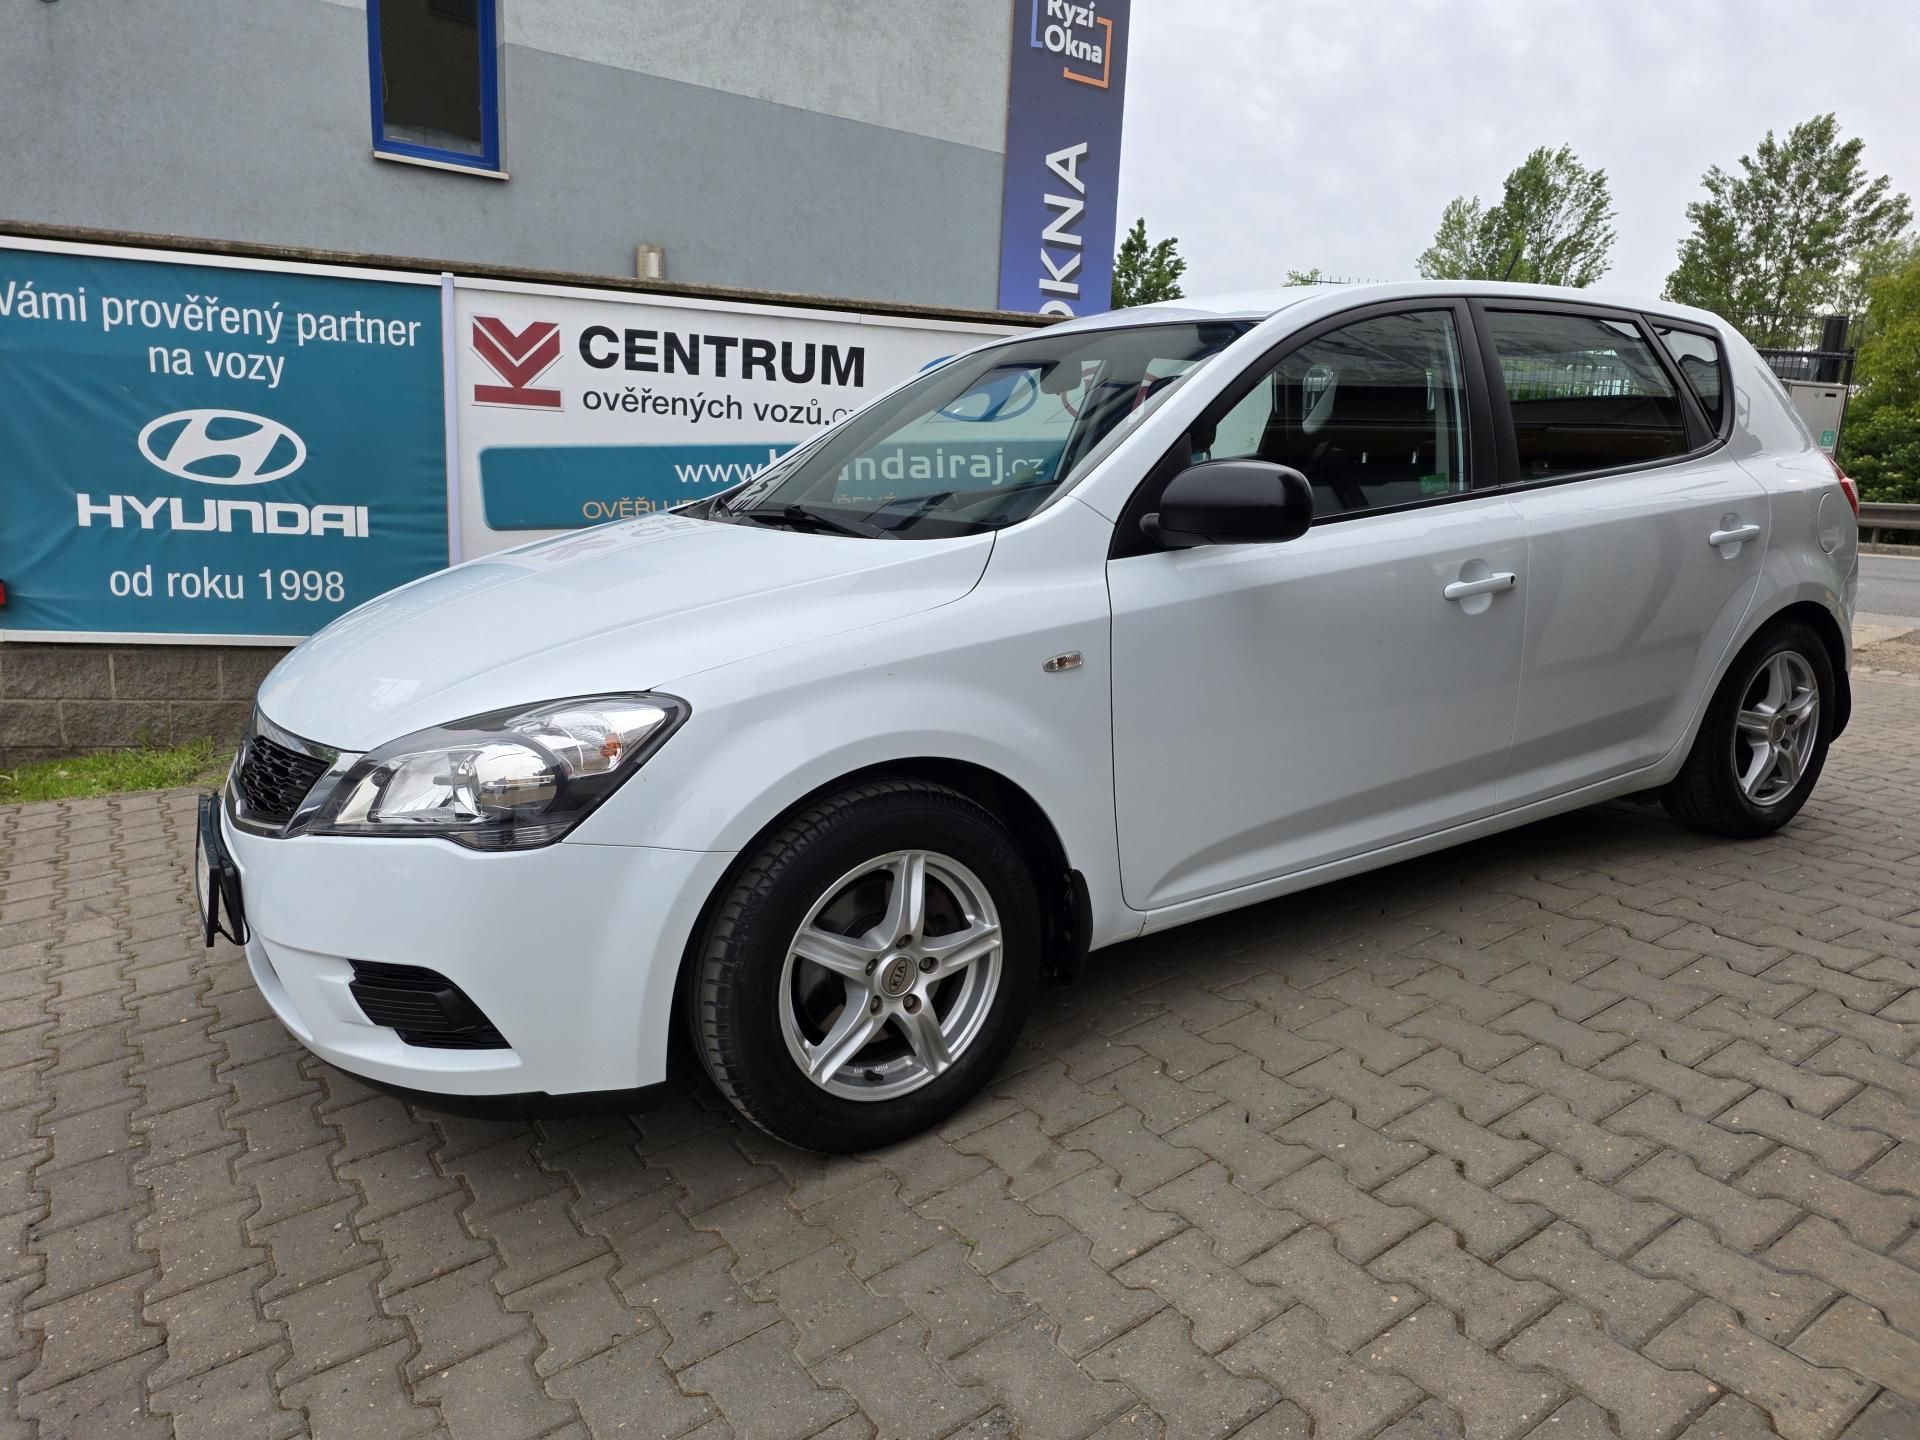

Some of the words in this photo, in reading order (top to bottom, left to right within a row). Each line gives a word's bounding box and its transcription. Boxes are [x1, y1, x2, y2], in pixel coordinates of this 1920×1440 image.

[1044, 24, 1102, 64] Okna
[102, 294, 283, 344] prověřený
[297, 310, 421, 346] partner
[149, 346, 194, 376] na
[205, 352, 285, 388] vozy
[578, 325, 866, 388] CENTRUM
[582, 387, 743, 423] ověřených
[76, 492, 370, 538] HYUNDAI
[110, 564, 153, 597] od
[167, 566, 245, 600] roku
[259, 568, 346, 603] 1998
[891, 965, 906, 987] KIA
